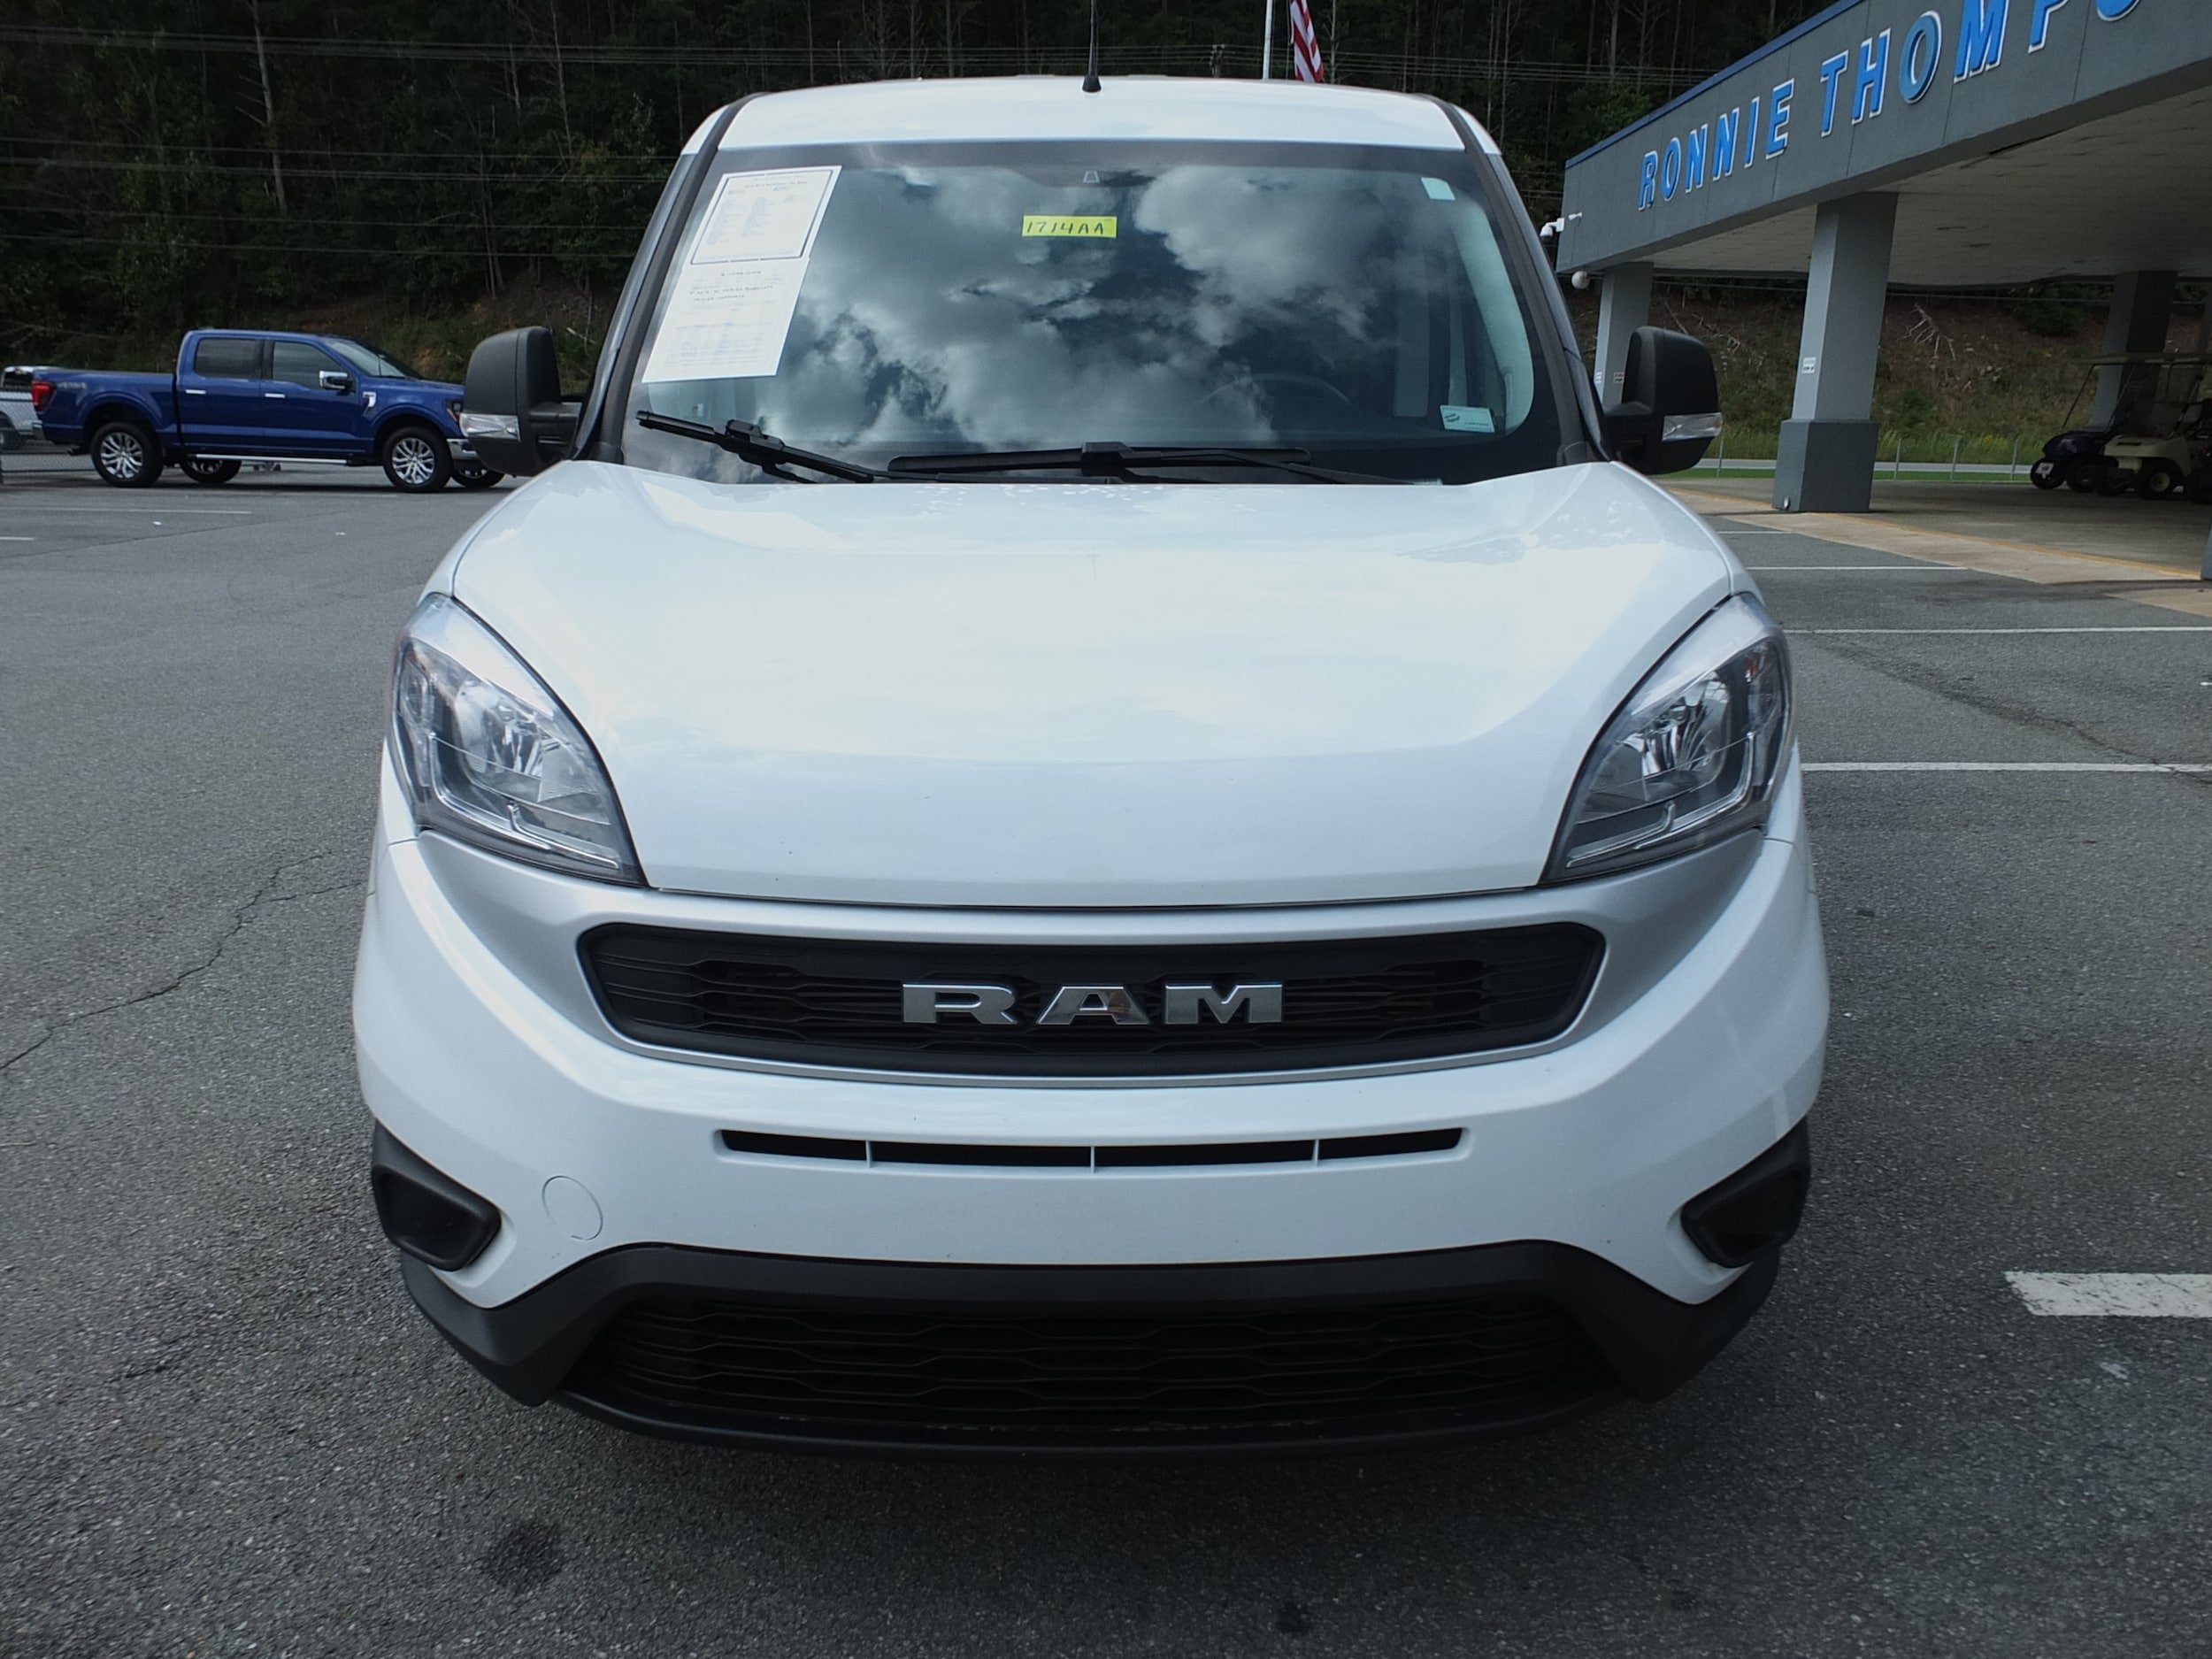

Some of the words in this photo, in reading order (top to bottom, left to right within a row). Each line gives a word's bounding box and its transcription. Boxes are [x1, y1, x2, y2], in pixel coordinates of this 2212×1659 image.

[1639, 78, 1794, 211] RONNIE
[1820, 0, 2140, 137] THOM
[902, 982, 1283, 1025] RAM
